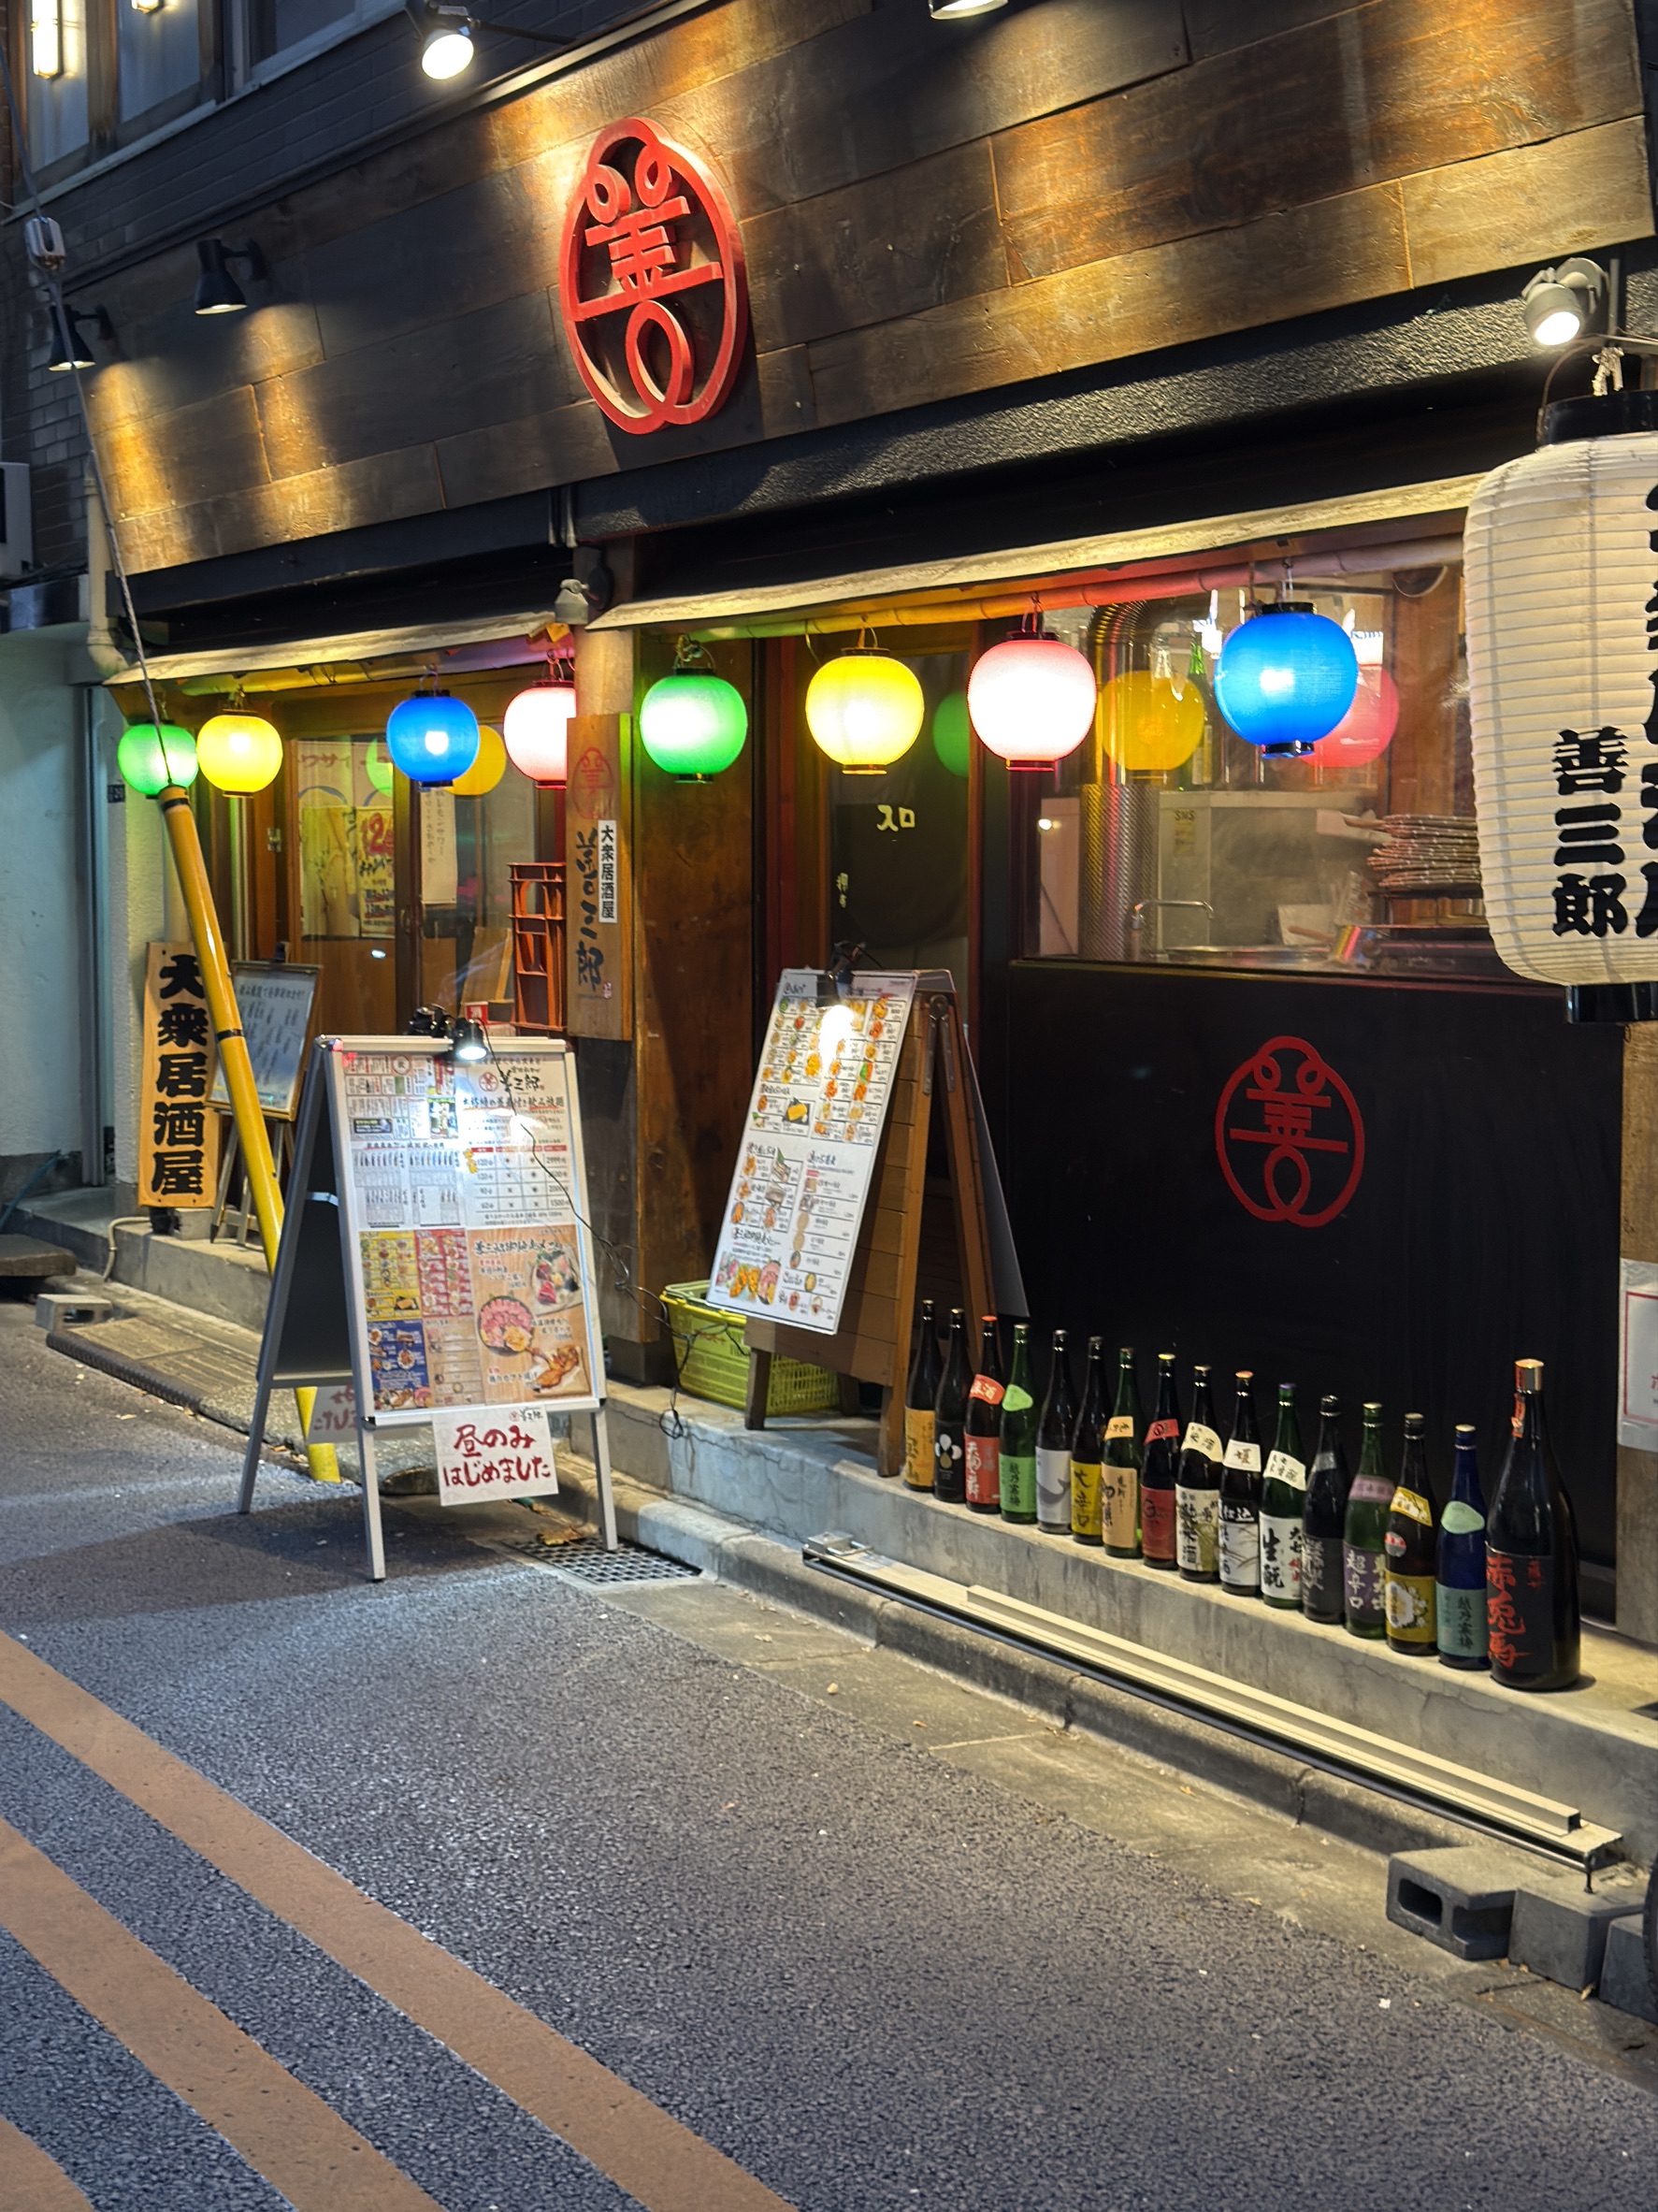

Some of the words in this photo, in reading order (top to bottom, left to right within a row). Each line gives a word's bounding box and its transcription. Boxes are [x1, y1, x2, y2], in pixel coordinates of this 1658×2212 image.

[1551, 726, 1629, 940] 善三郎
[601, 825, 614, 919] 大衆居酒屋
[151, 954, 208, 1195] 大衆居酒屋
[442, 1455, 552, 1488] はじめました
[454, 1424, 537, 1458] 昼のみ
[1347, 1549, 1368, 1610] 超辛口
